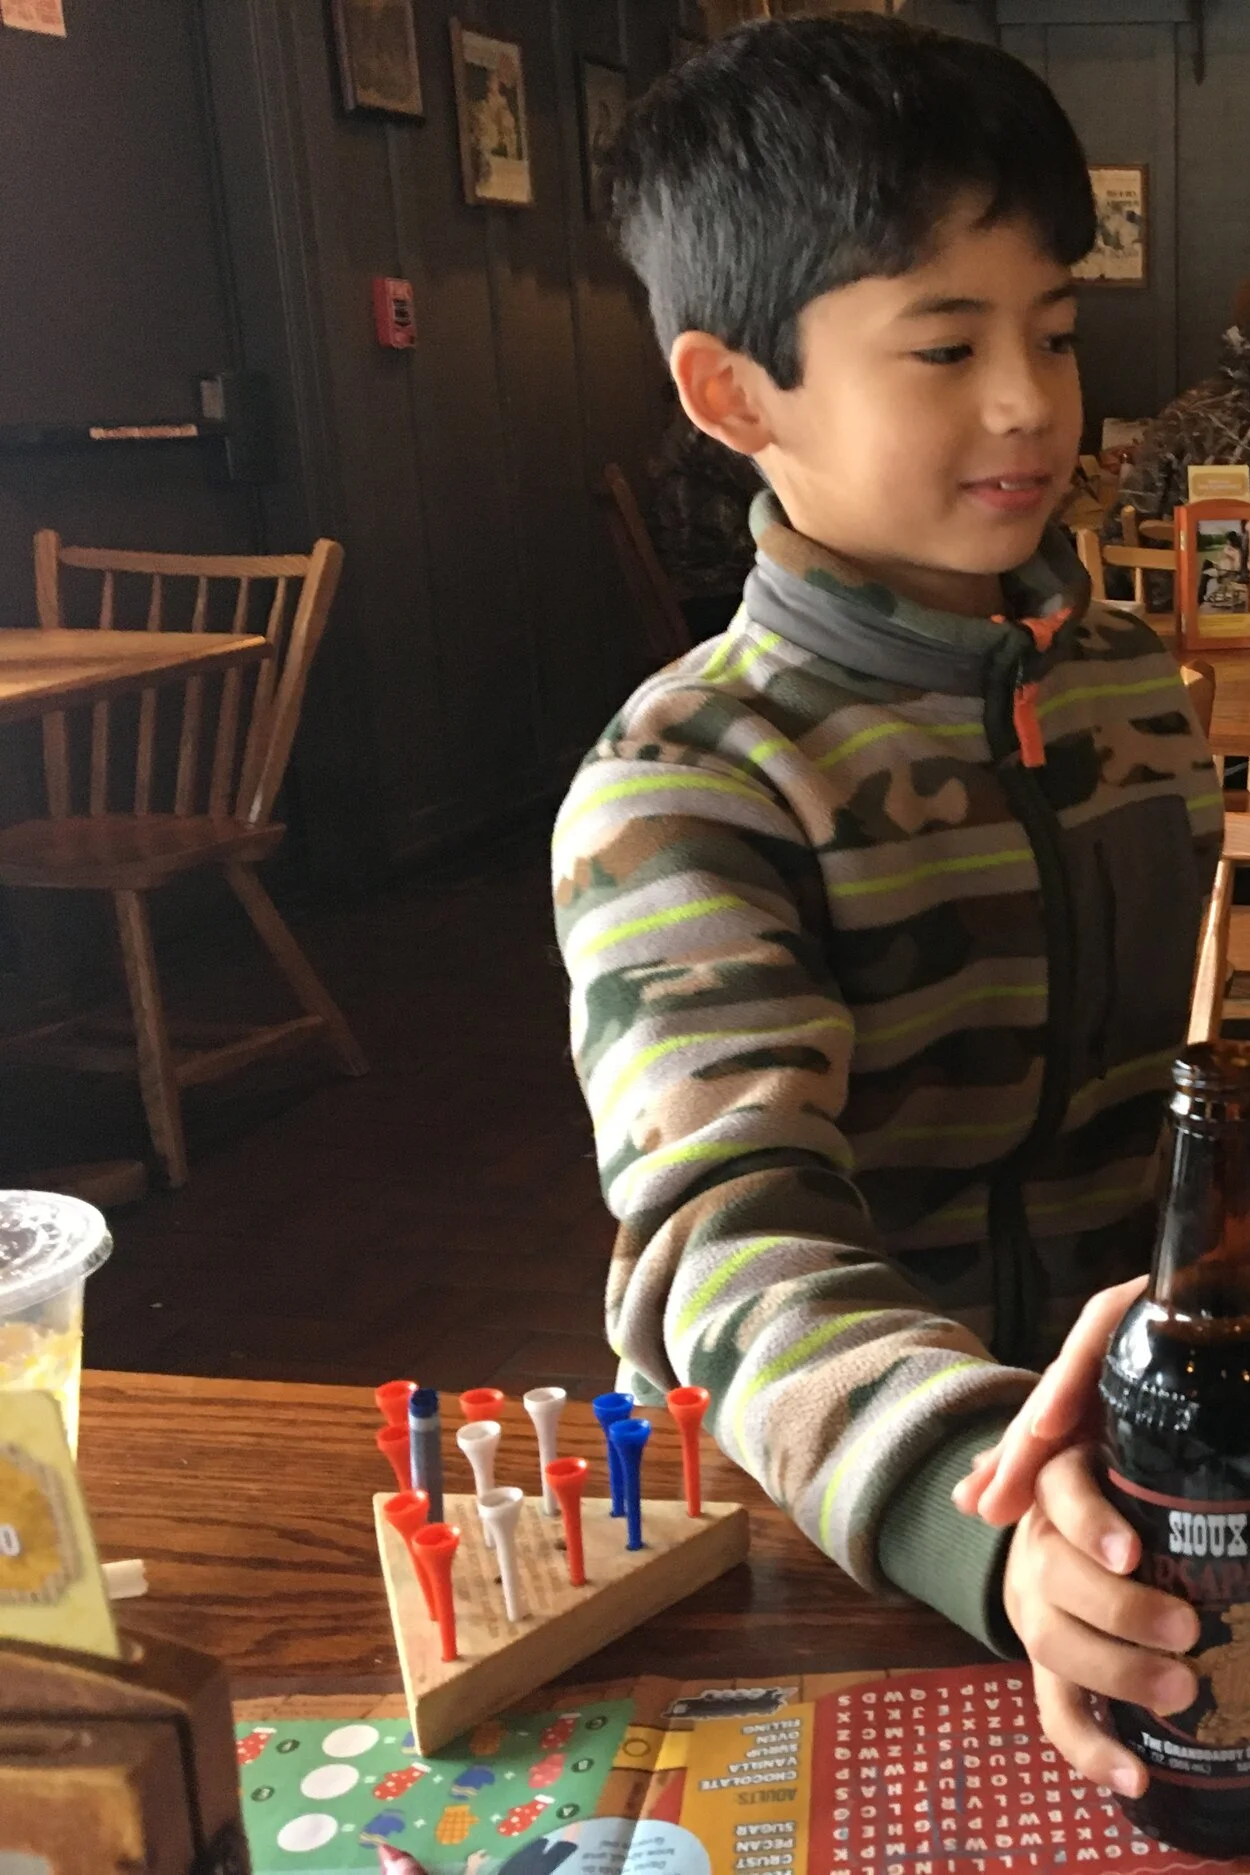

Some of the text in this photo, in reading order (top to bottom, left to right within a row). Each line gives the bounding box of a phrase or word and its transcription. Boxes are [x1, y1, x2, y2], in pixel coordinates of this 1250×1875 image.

[1169, 1510, 1248, 1557] SIOUX
[884, 1691, 904, 1702] W
[938, 1688, 948, 1698] L
[960, 1685, 974, 1695] P
[838, 1694, 850, 1706] S
[963, 1701, 974, 1712] T
[985, 1698, 999, 1710] A
[1012, 1697, 1023, 1707] L
[837, 1712, 851, 1723] X
[864, 1710, 874, 1721] L
[913, 1707, 924, 1718] J
[962, 1718, 975, 1730] X
[988, 1716, 1000, 1728] Z
[1014, 1715, 1025, 1726] F
[885, 1727, 903, 1738] M
[915, 1725, 925, 1736] L
[938, 1722, 952, 1734] P
[757, 1730, 800, 1744] OVEN
[837, 1729, 850, 1741] Z
[962, 1735, 979, 1748] U
[888, 1745, 901, 1757] Z
[914, 1743, 926, 1755] T
[938, 1738, 952, 1752] S
[858, 1747, 879, 1759] W
[728, 1757, 797, 1773] VANILLA
[937, 1757, 953, 1771] P
[989, 1754, 1006, 1766] U
[860, 1766, 879, 1780] N
[884, 1763, 905, 1776] W
[913, 1761, 928, 1773] R
[701, 1770, 797, 1790] CHOCOLATE
[835, 1768, 850, 1780] P
[1018, 1772, 1031, 1784] L
[1042, 1770, 1059, 1783] N
[915, 1780, 930, 1792] T
[939, 1778, 956, 1789] U
[836, 1788, 848, 1800] S
[861, 1785, 880, 1798] A
[1071, 1787, 1086, 1800] A
[915, 1800, 929, 1812] P
[942, 1797, 956, 1810] R
[967, 1796, 982, 1808] V
[995, 1794, 1007, 1807] L
[889, 1803, 901, 1815] L
[1074, 1806, 1090, 1820] V
[1101, 1804, 1113, 1816] L
[968, 1817, 982, 1829] P
[996, 1815, 1009, 1828] F
[1018, 1812, 1040, 1826] W
[736, 1822, 794, 1836] SUGAR
[1077, 1827, 1092, 1840] K
[1020, 1832, 1043, 1846] W
[1051, 1830, 1066, 1843] Z
[736, 1839, 793, 1852] PECAN
[886, 1843, 905, 1856] M
[917, 1841, 929, 1854] F
[944, 1838, 956, 1851] S
[965, 1838, 987, 1851] W
[834, 1846, 852, 1861] K
[860, 1845, 876, 1859] P
[1028, 1850, 1037, 1865] I
[1076, 1847, 1099, 1860] W
[736, 1854, 793, 1868] CRUST
[948, 1859, 955, 1872] I
[973, 1858, 985, 1871] L
[1000, 1855, 1012, 1867] L
[916, 1861, 932, 1875] N
